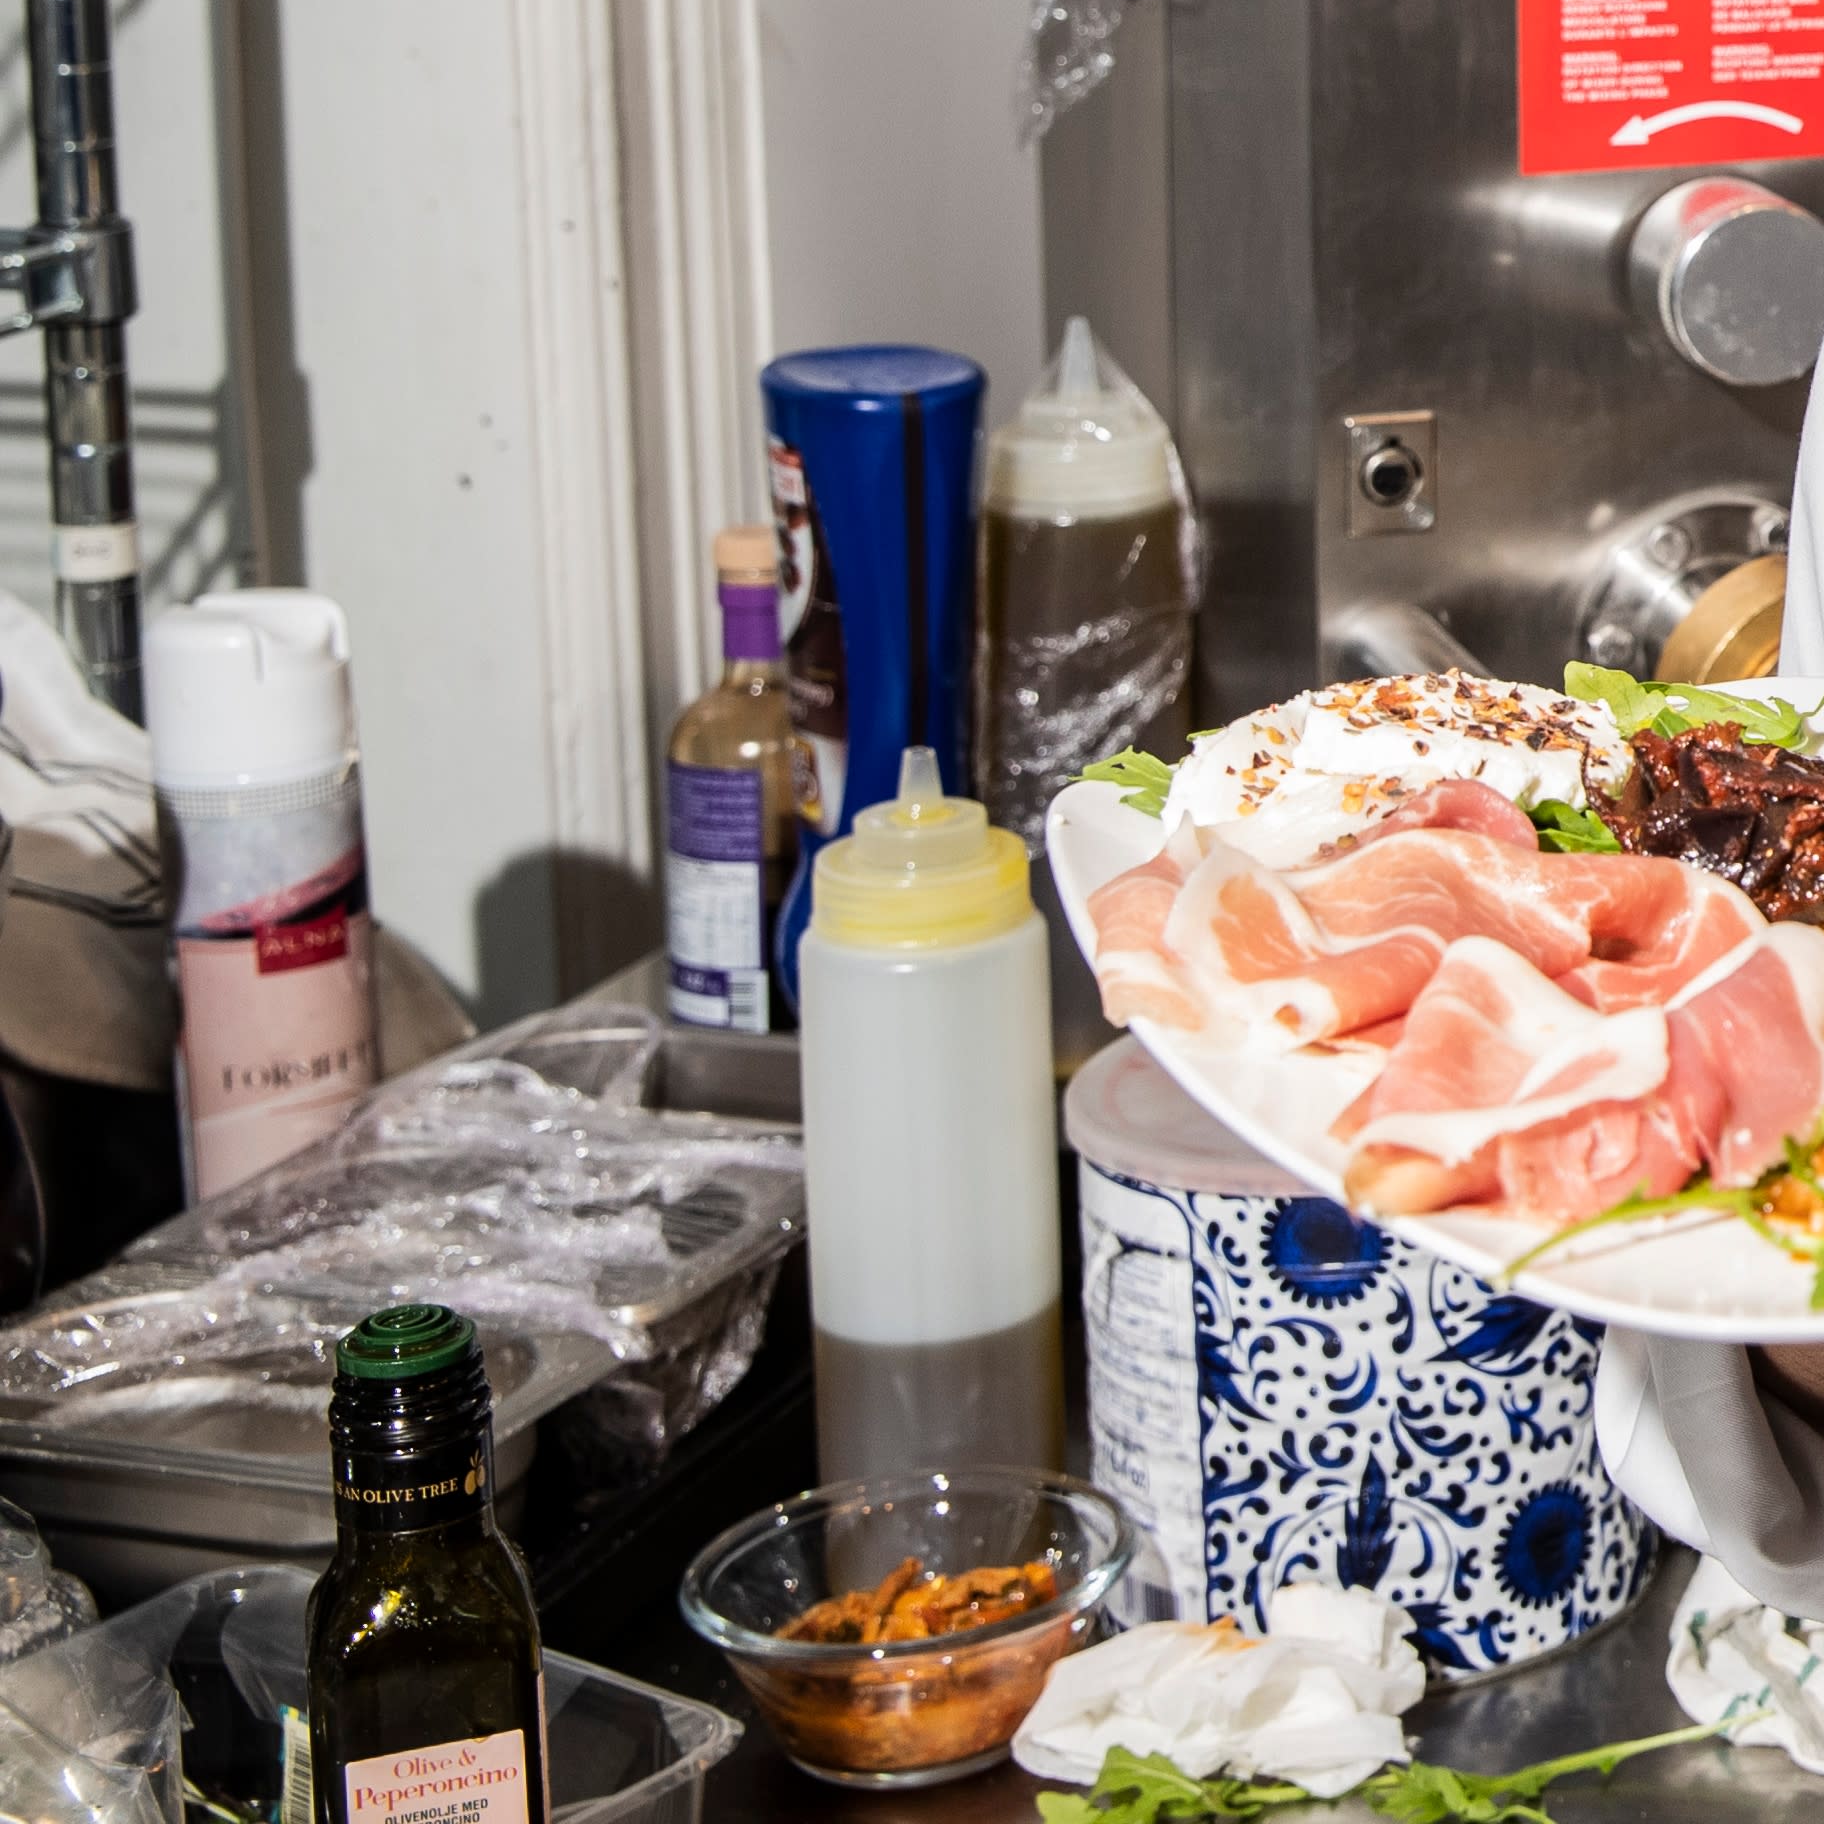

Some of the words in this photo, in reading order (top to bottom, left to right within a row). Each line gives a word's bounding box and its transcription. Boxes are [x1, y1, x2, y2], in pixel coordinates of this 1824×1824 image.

[363, 1489, 415, 1504] OLIVE
[418, 1477, 459, 1500] TREE
[393, 1756, 453, 1779] Olive
[458, 1747, 477, 1768] &
[354, 1765, 518, 1812] Peperoncino
[384, 1803, 458, 1824] OLIVENOLJE
[462, 1798, 488, 1813] MED
